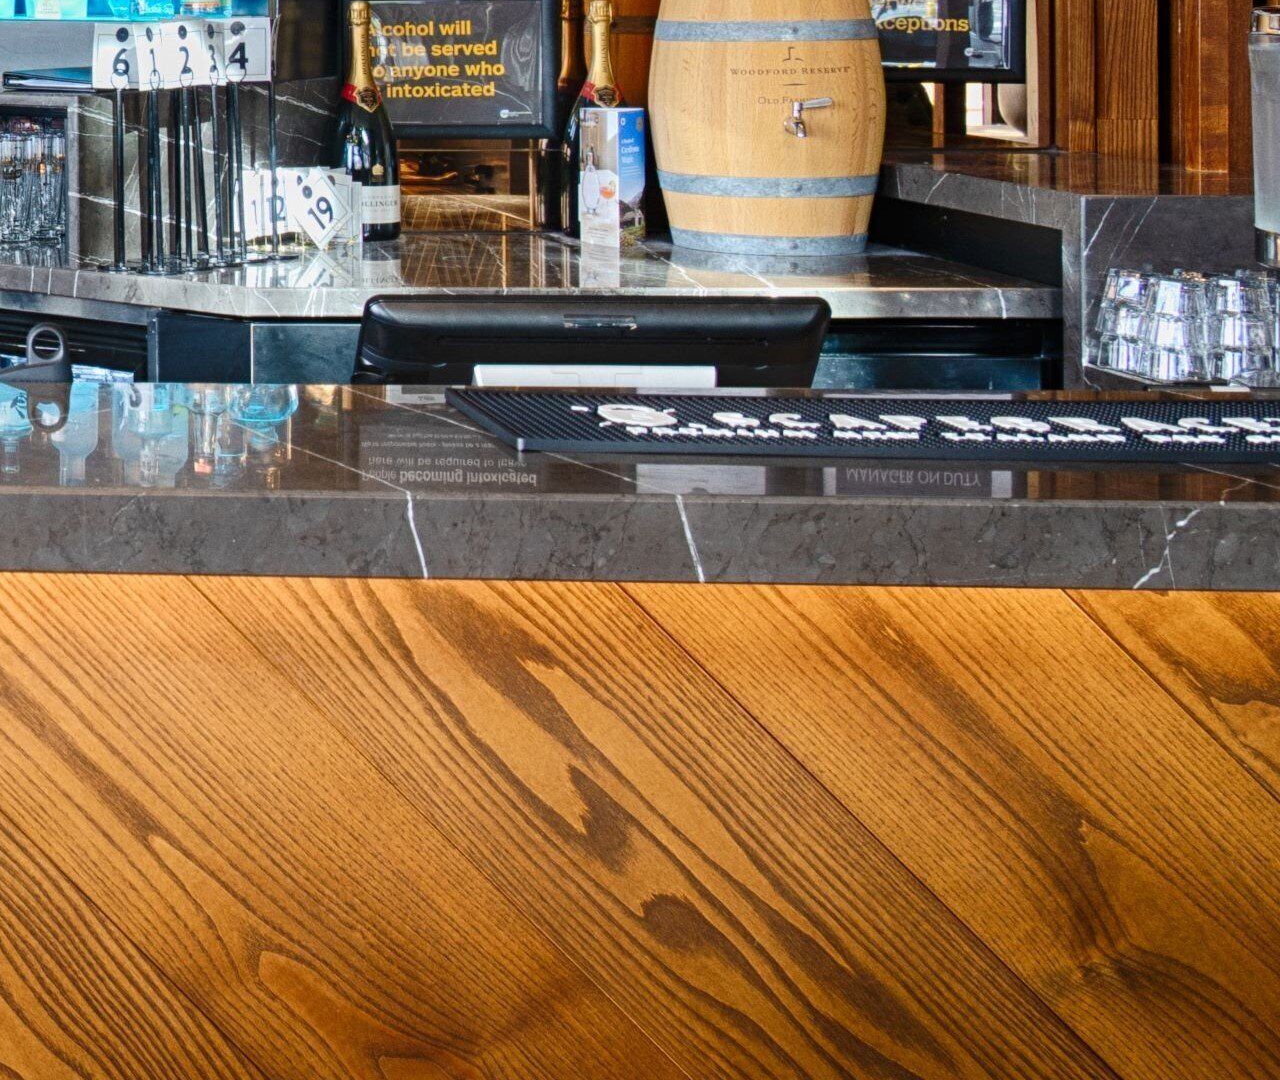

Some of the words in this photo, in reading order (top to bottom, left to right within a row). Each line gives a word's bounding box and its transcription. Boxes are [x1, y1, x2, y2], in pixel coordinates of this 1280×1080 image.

[368, 21, 434, 37] Acohol
[439, 20, 471, 36] will
[179, 45, 192, 75] 2
[229, 41, 248, 70] 4
[402, 42, 426, 57] be
[431, 40, 497, 56] served
[113, 48, 130, 76] 6
[149, 48, 157, 76] 1
[391, 64, 460, 81] anyone
[464, 61, 505, 77] who
[730, 68, 797, 76] WOODFORD
[801, 66, 851, 75] RESERVE
[386, 82, 495, 99] intoxicated
[307, 196, 334, 230] 19
